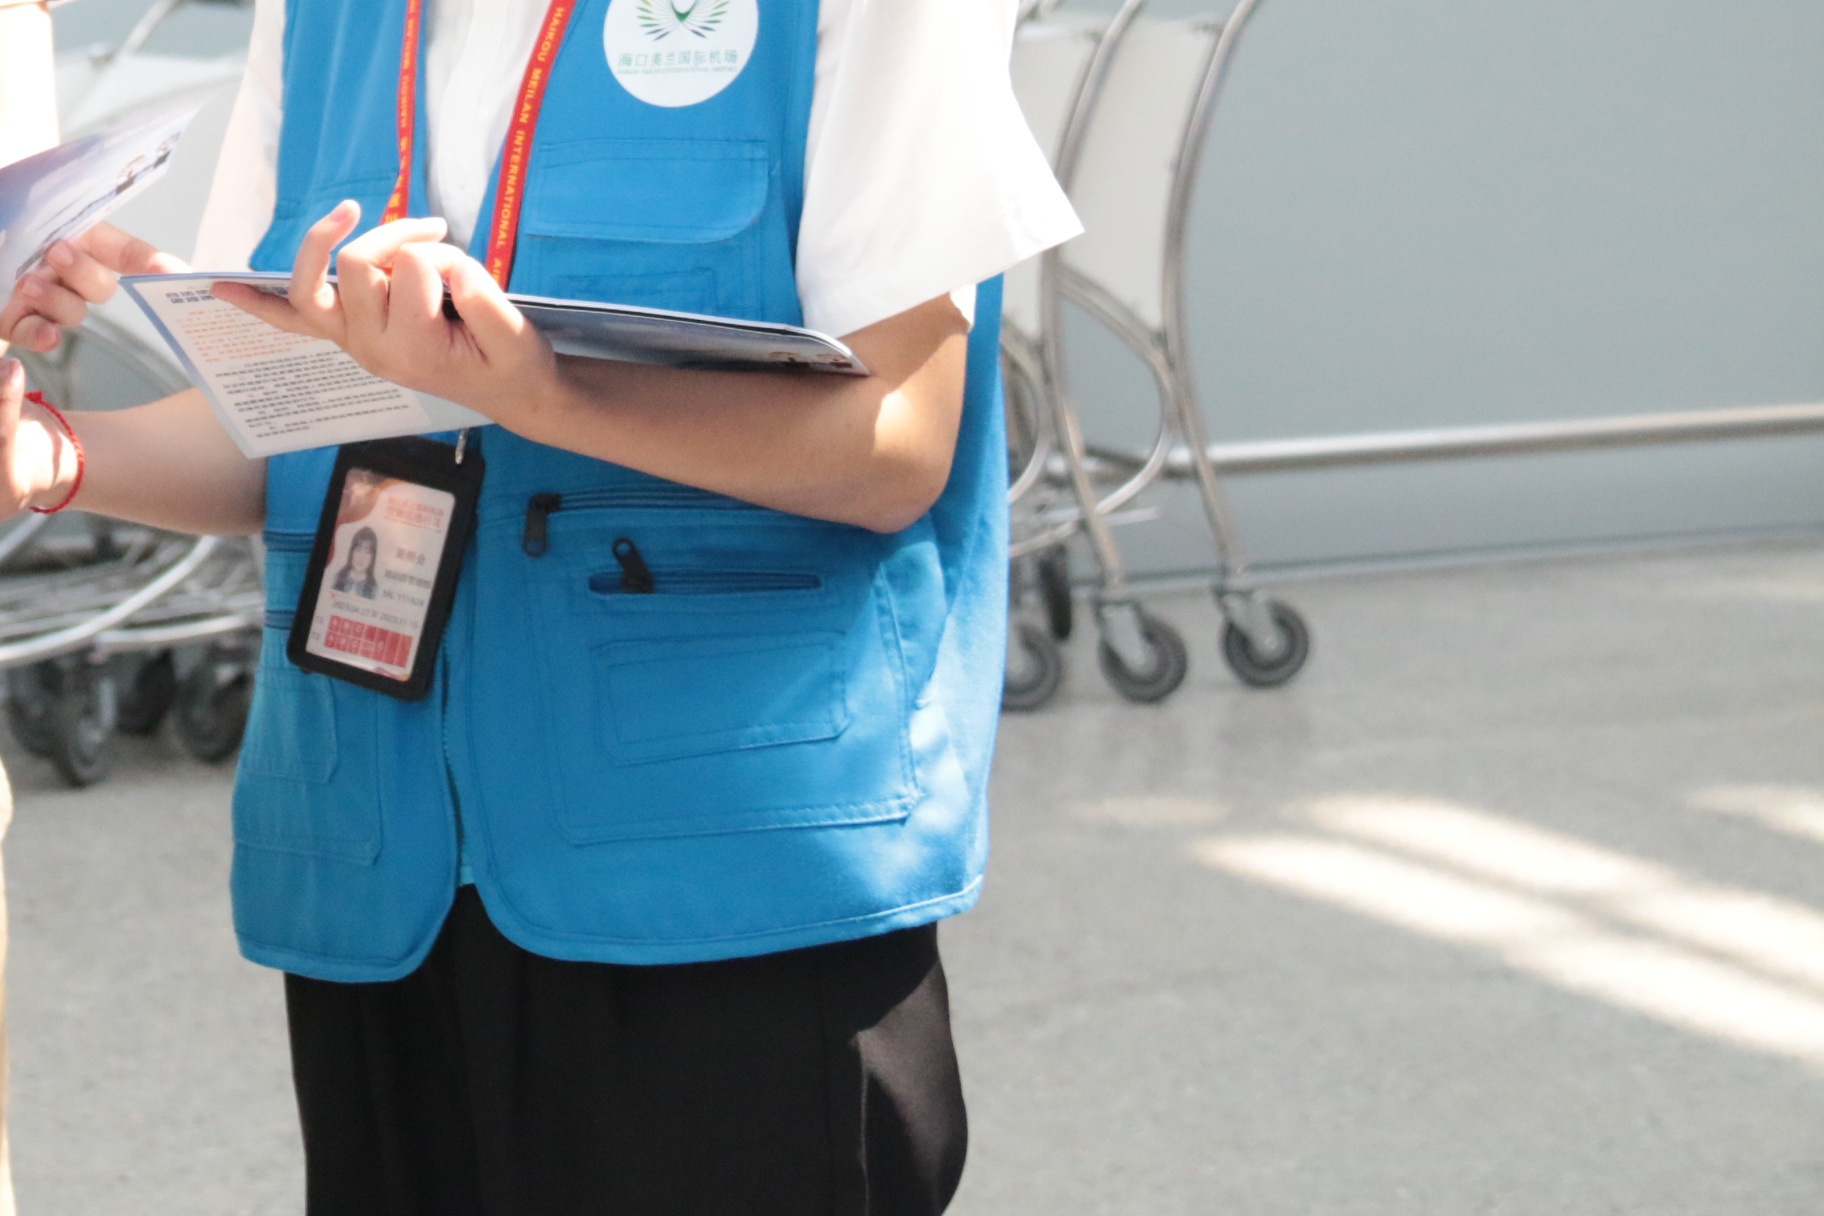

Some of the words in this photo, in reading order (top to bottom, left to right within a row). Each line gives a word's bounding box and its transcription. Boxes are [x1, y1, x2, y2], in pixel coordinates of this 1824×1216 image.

[537, 6, 565, 62] HAIKOU
[519, 67, 543, 123] MEILAN
[495, 129, 526, 247] INTERNATIONAL
